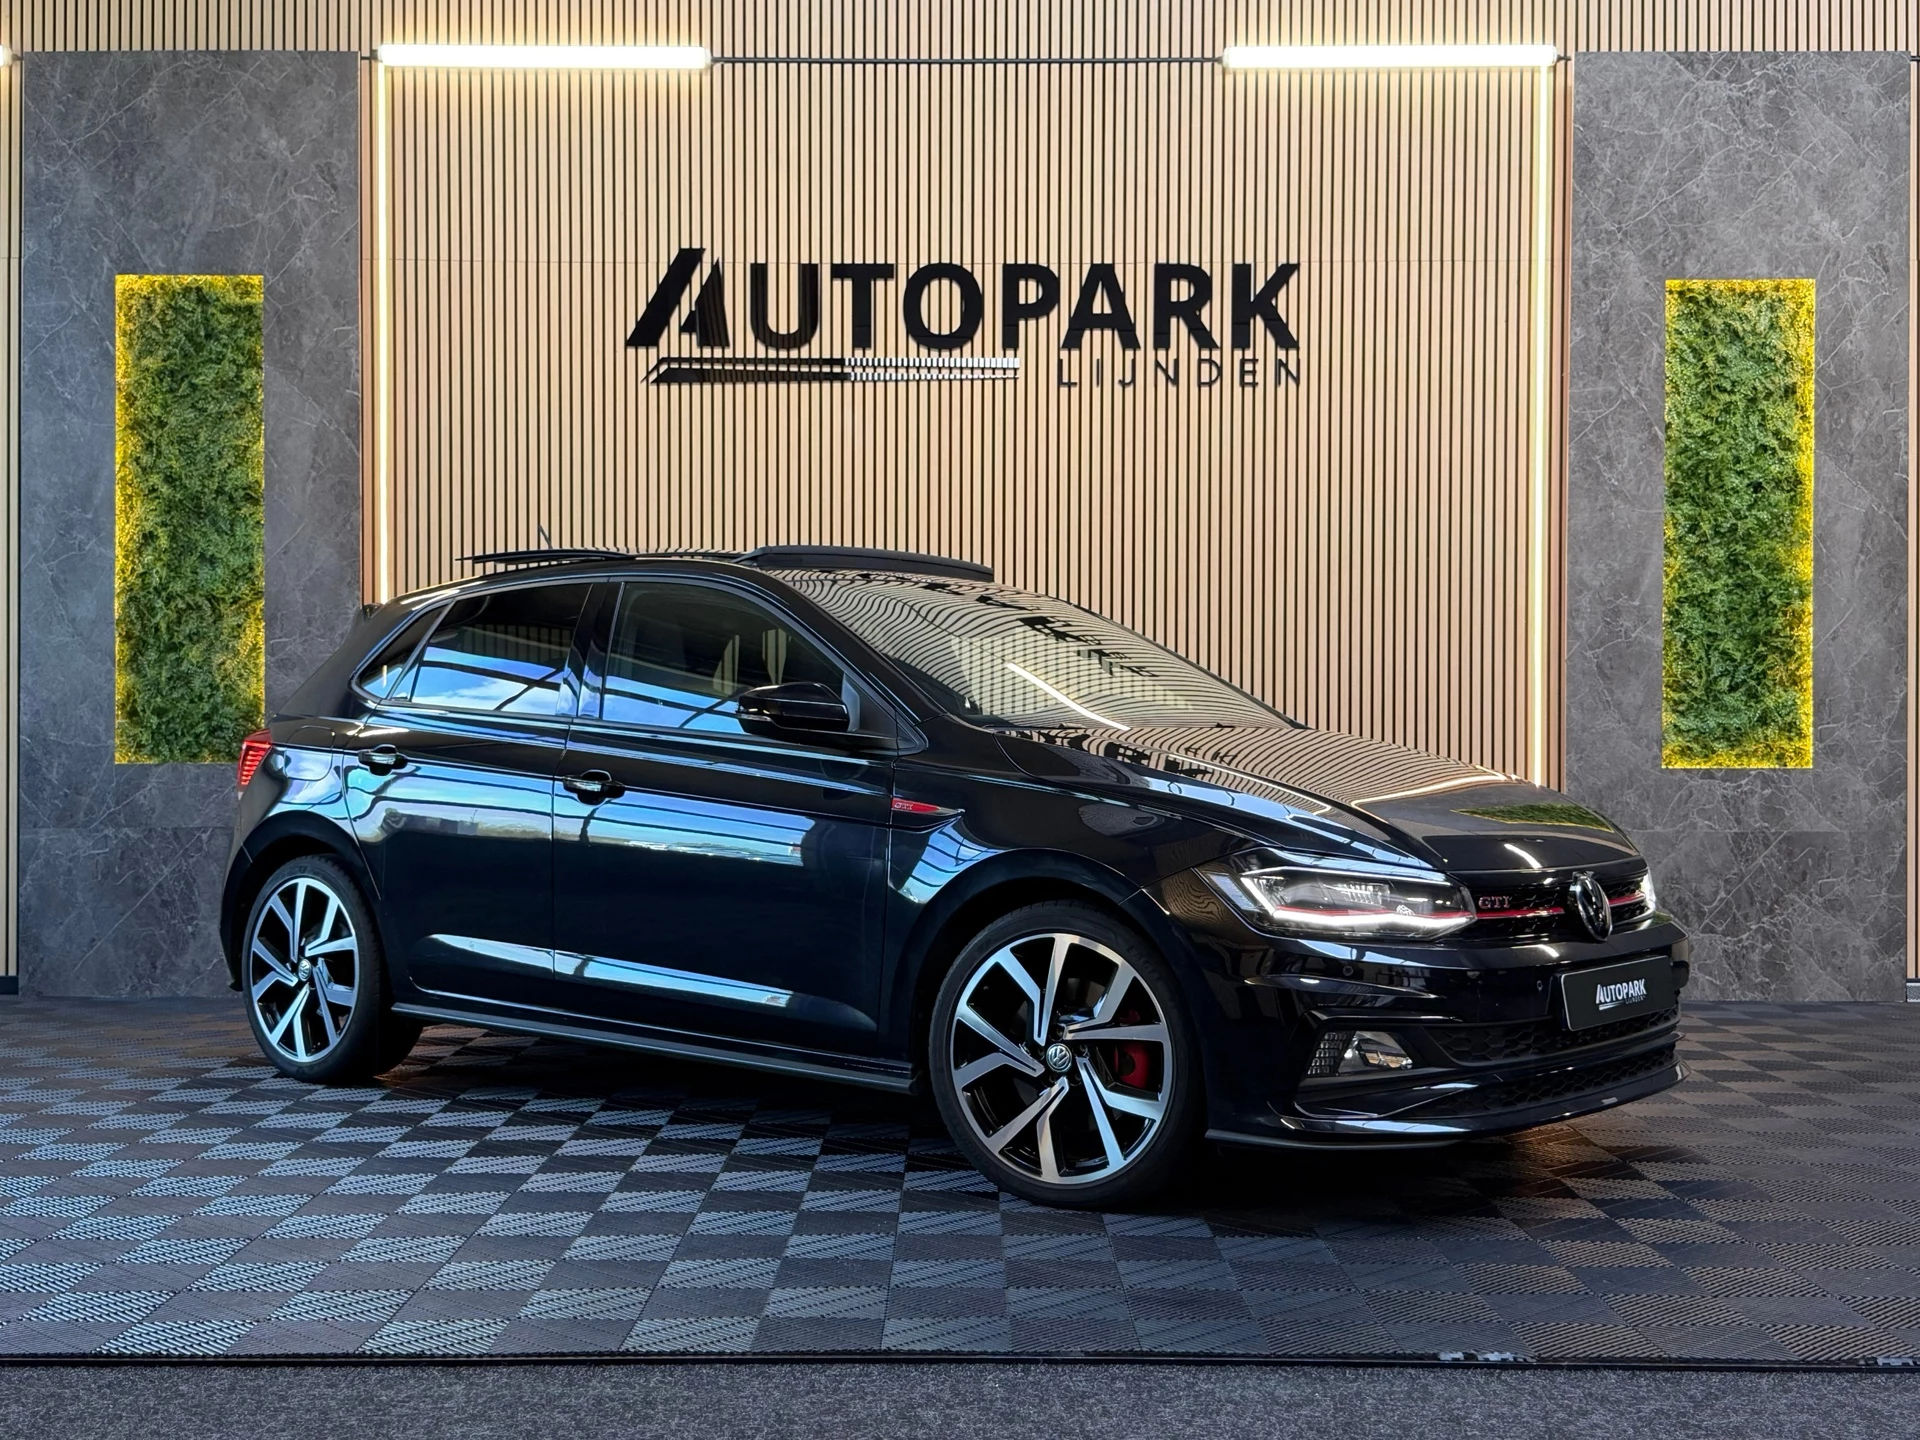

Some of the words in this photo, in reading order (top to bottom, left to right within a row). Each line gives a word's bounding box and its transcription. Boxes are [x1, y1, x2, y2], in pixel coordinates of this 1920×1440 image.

[625, 247, 1300, 350] AUTOPARK
[1056, 358, 1300, 388] LIJNDEN
[1478, 895, 1510, 909] GTI
[1595, 978, 1647, 1004] AUTOPARK
